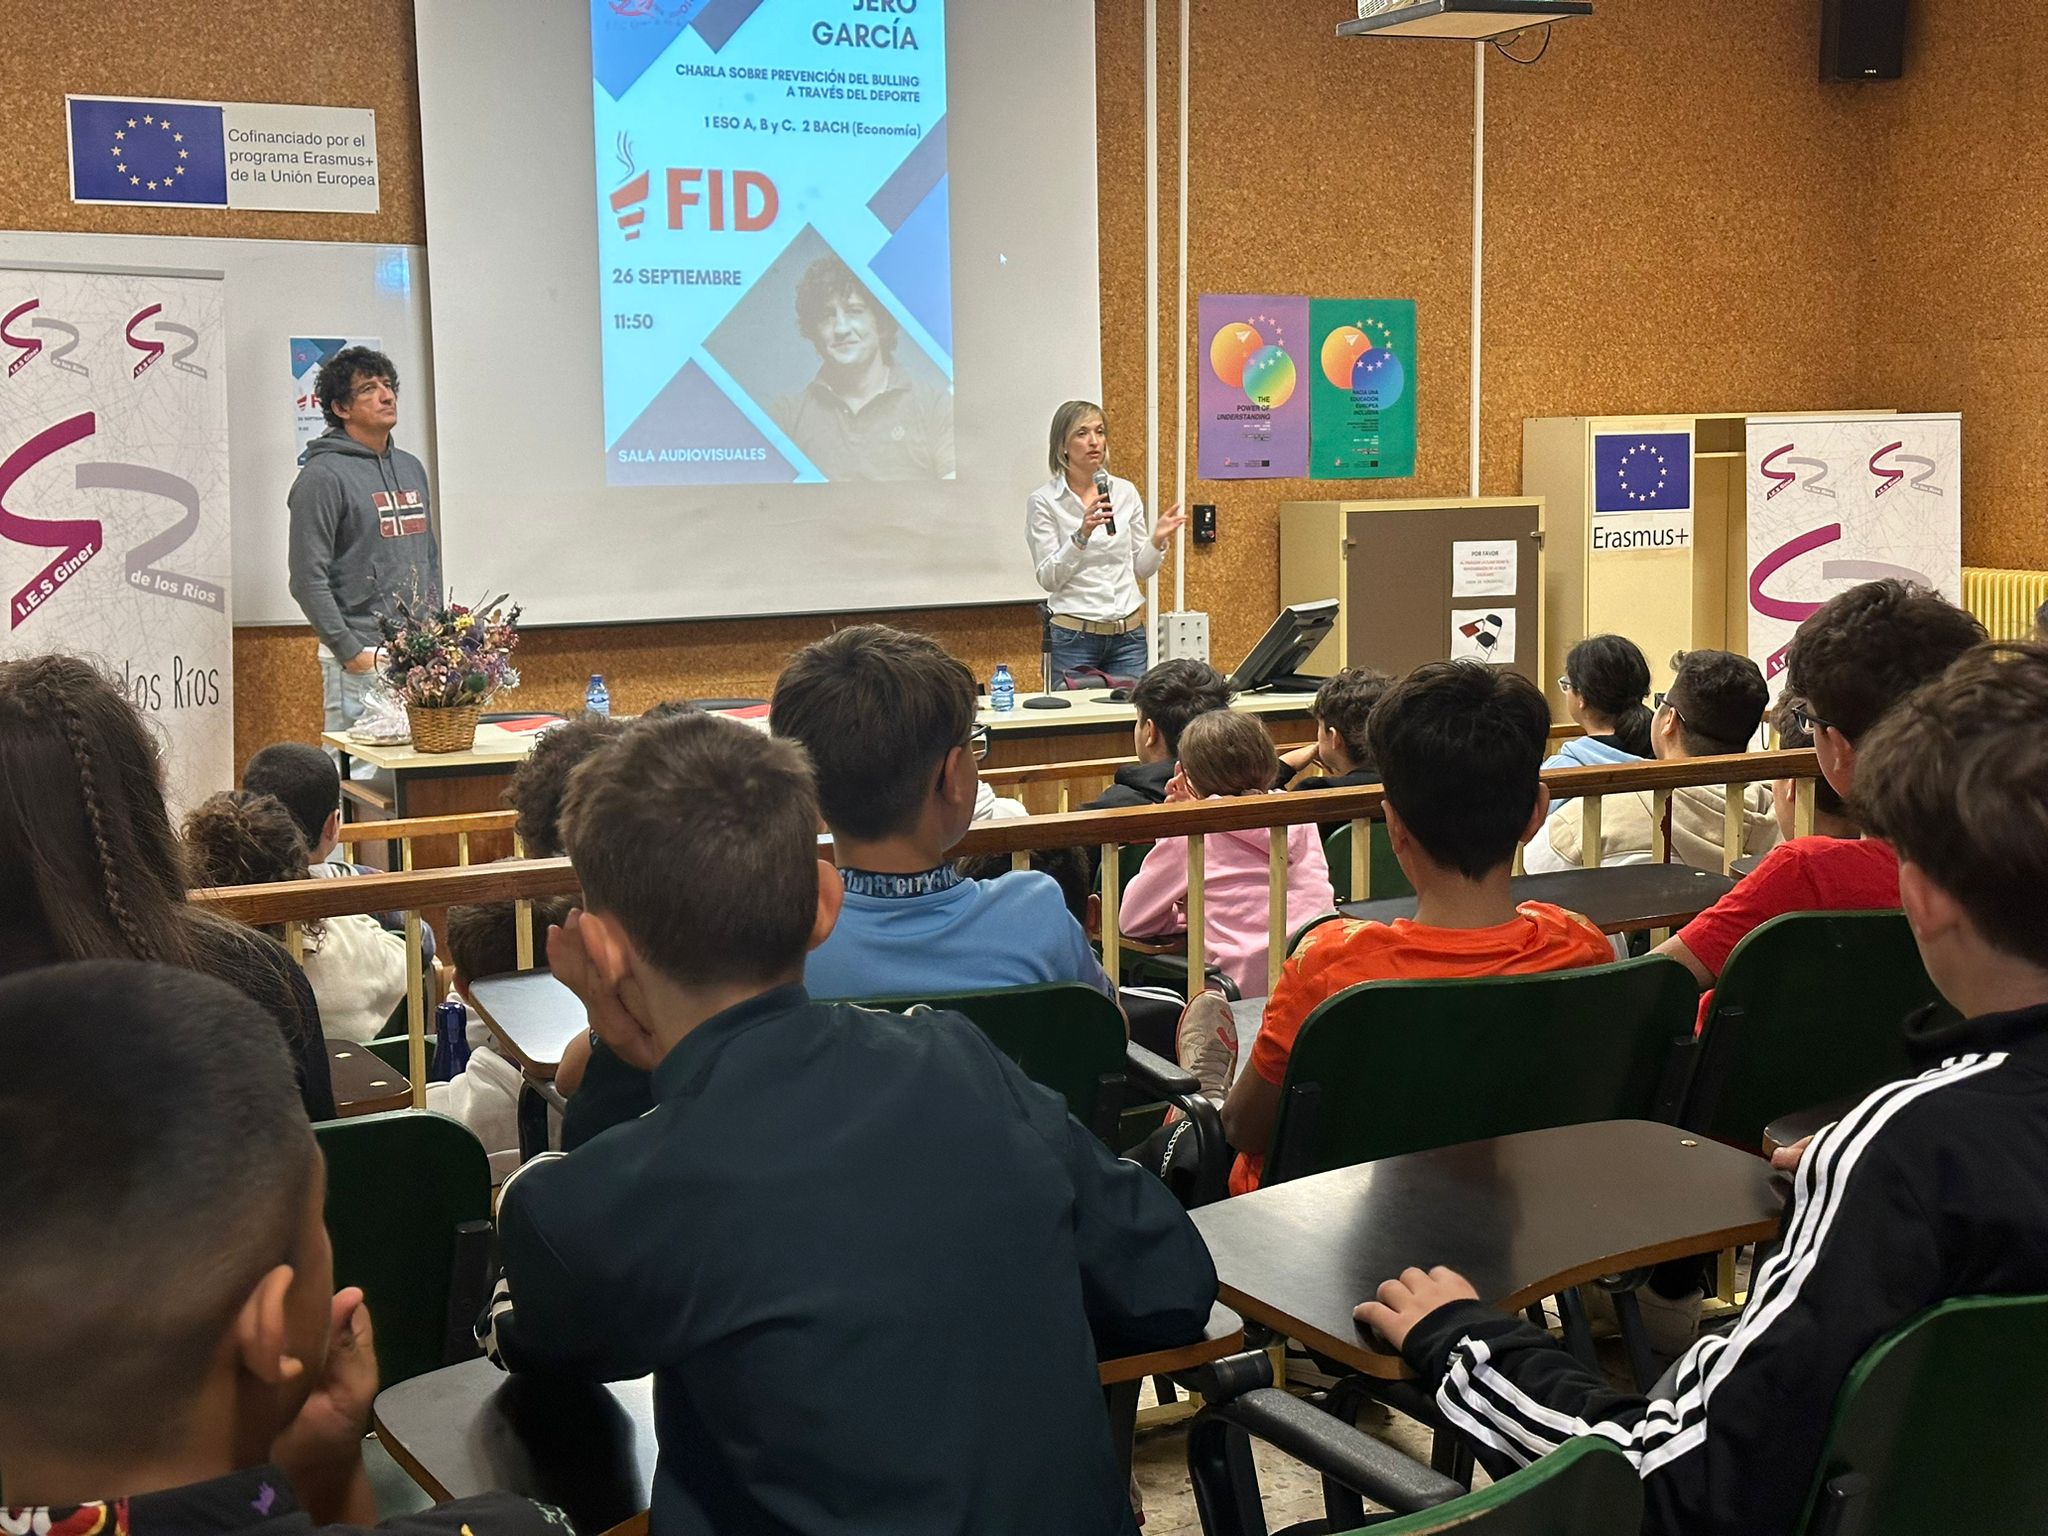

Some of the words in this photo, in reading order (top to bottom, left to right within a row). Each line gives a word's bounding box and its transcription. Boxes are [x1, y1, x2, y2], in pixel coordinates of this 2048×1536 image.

[812, 17, 919, 50] GARCÍA
[675, 64, 726, 78] CHARLA
[729, 67, 769, 80] SOBRE
[771, 68, 845, 84] PREVENCIÓN
[848, 73, 869, 85] DEL
[872, 74, 919, 87] BULLING
[786, 86, 796, 97] A
[799, 85, 844, 99] TRAVÉS
[847, 89, 868, 101] DEL
[870, 90, 920, 102] DEPORTE
[704, 116, 710, 128] 1
[713, 116, 740, 129] ESO
[743, 118, 757, 132] A,
[760, 119, 769, 131] B
[771, 121, 779, 134] y
[782, 119, 797, 132] C.
[802, 120, 811, 132] 2
[813, 121, 849, 134] BACH
[852, 122, 921, 138] (Economía)
[228, 129, 322, 145] Cofinanciado
[327, 136, 349, 148] por
[353, 135, 365, 147] el
[230, 151, 299, 165] programa
[304, 152, 374, 166] Erasmus+
[230, 169, 249, 181] de
[254, 170, 266, 182] la
[271, 170, 312, 183] Unión
[317, 171, 375, 188] Europea
[666, 167, 779, 232] FID
[612, 268, 634, 284] 26
[638, 269, 742, 285] SEPTIEMBRE
[614, 314, 654, 329] 11:50
[618, 449, 655, 463] SALA
[658, 448, 766, 462] AUDIOVISUALES
[1593, 526, 1689, 549] Erasmus+
[16, 578, 54, 617] I.E.S
[54, 541, 95, 583] Giner
[130, 570, 151, 586] de
[154, 575, 178, 594] los
[173, 655, 220, 710] Ríos
